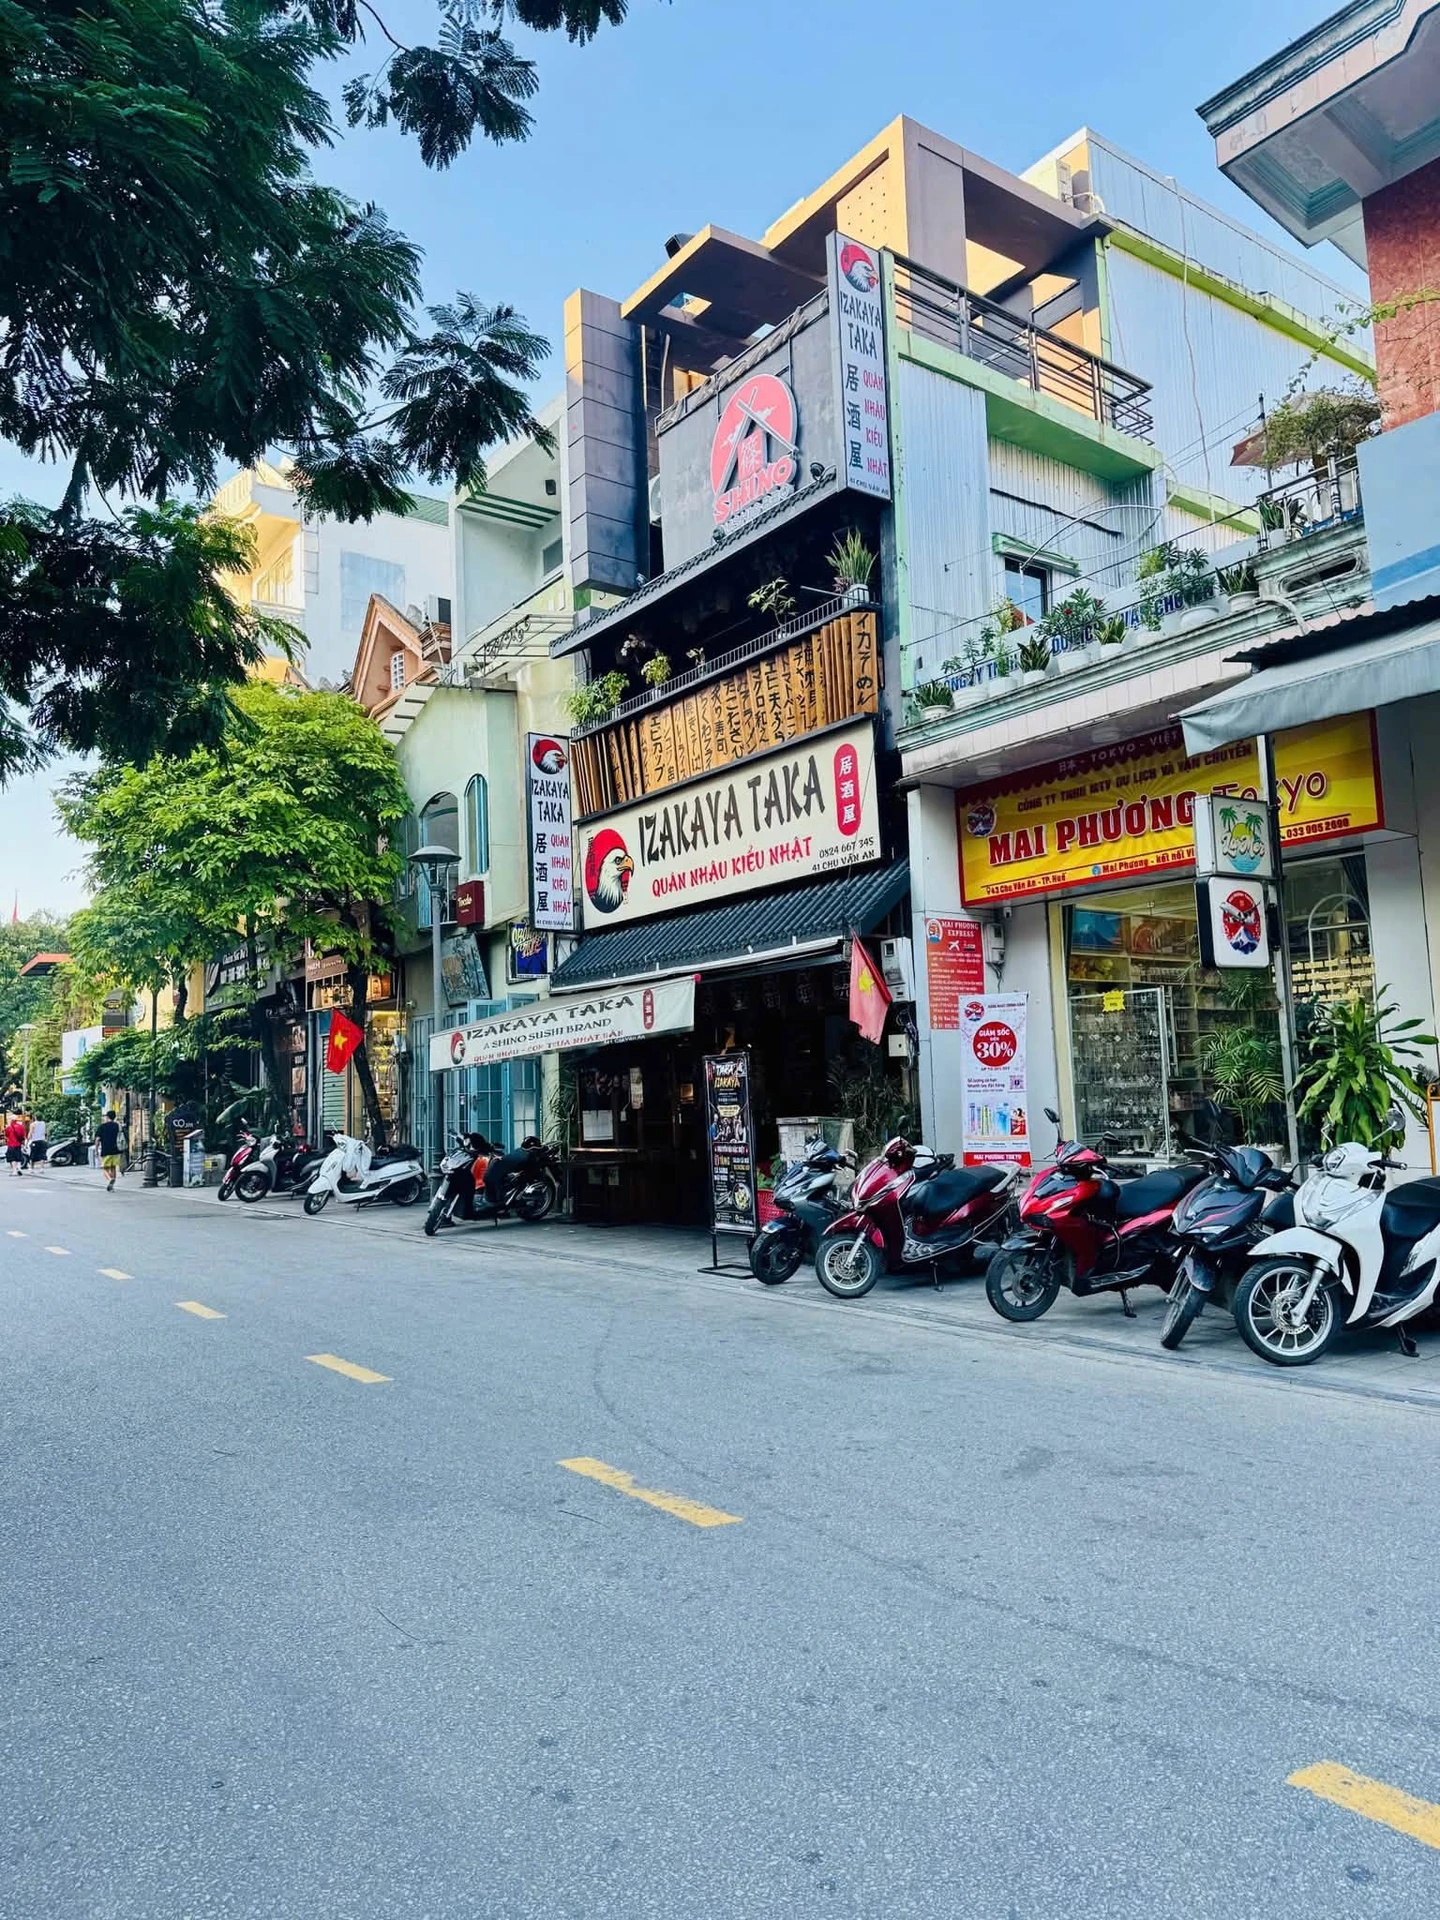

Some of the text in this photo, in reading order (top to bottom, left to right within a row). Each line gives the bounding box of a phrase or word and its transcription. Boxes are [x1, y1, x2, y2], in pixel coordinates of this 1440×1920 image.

[840, 290, 882, 330] IZAKAYA
[848, 322, 877, 360] TAKA
[846, 363, 862, 469] 居酒屋
[714, 455, 793, 525] SHINO
[1091, 741, 1136, 762] TOKYO
[531, 779, 569, 799] IZAKAYA
[839, 755, 856, 825] 居酒屋
[538, 800, 564, 824] TAKA
[638, 784, 743, 867] IZAKAYA
[748, 755, 826, 832] TAKA
[988, 771, 1325, 867] MAI PHƯƠNG Tyo
[812, 863, 820, 871] 41
[822, 859, 839, 870] CHU
[862, 849, 875, 860] AN
[841, 840, 856, 853] 667
[859, 836, 874, 848] 345
[535, 832, 549, 912] 居酒屋
[652, 835, 813, 898] QUÁN NHẬU KIỂU NHẬT
[466, 995, 635, 1040] IZAKAYA TAKA
[491, 1033, 526, 1050] SHINO
[528, 1027, 564, 1043] SUSHI
[566, 1018, 612, 1034] BRAND
[976, 1041, 1014, 1059] 30%
